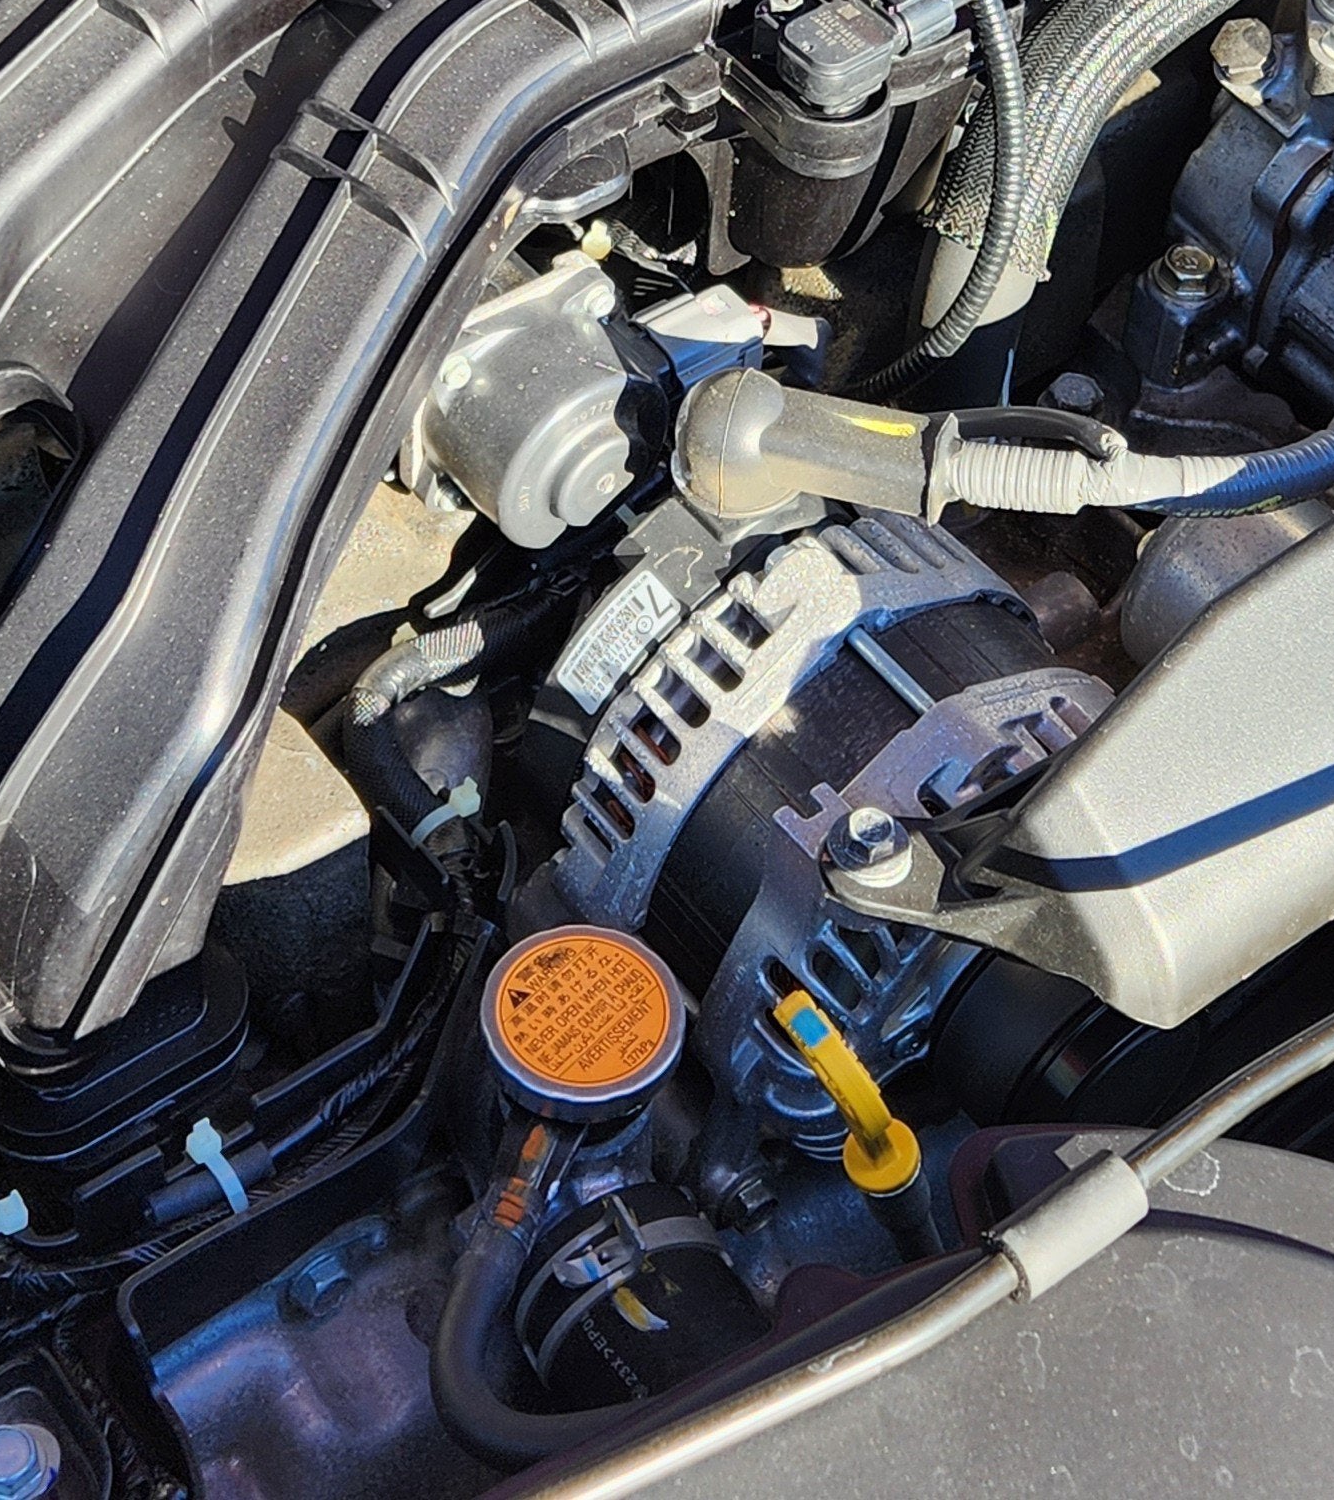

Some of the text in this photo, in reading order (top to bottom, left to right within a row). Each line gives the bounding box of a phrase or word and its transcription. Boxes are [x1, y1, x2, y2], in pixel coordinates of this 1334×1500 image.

[527, 947, 576, 993] WARNING
[525, 1025, 558, 1056] NEVER
[556, 1002, 584, 1027] OPEN
[581, 975, 612, 1005] WHEN
[576, 999, 653, 1072] AVERTISSEMENT
[537, 1048, 555, 1067] NE
[550, 1024, 581, 1054] JAMAIS
[622, 1037, 656, 1069] 137kPa
